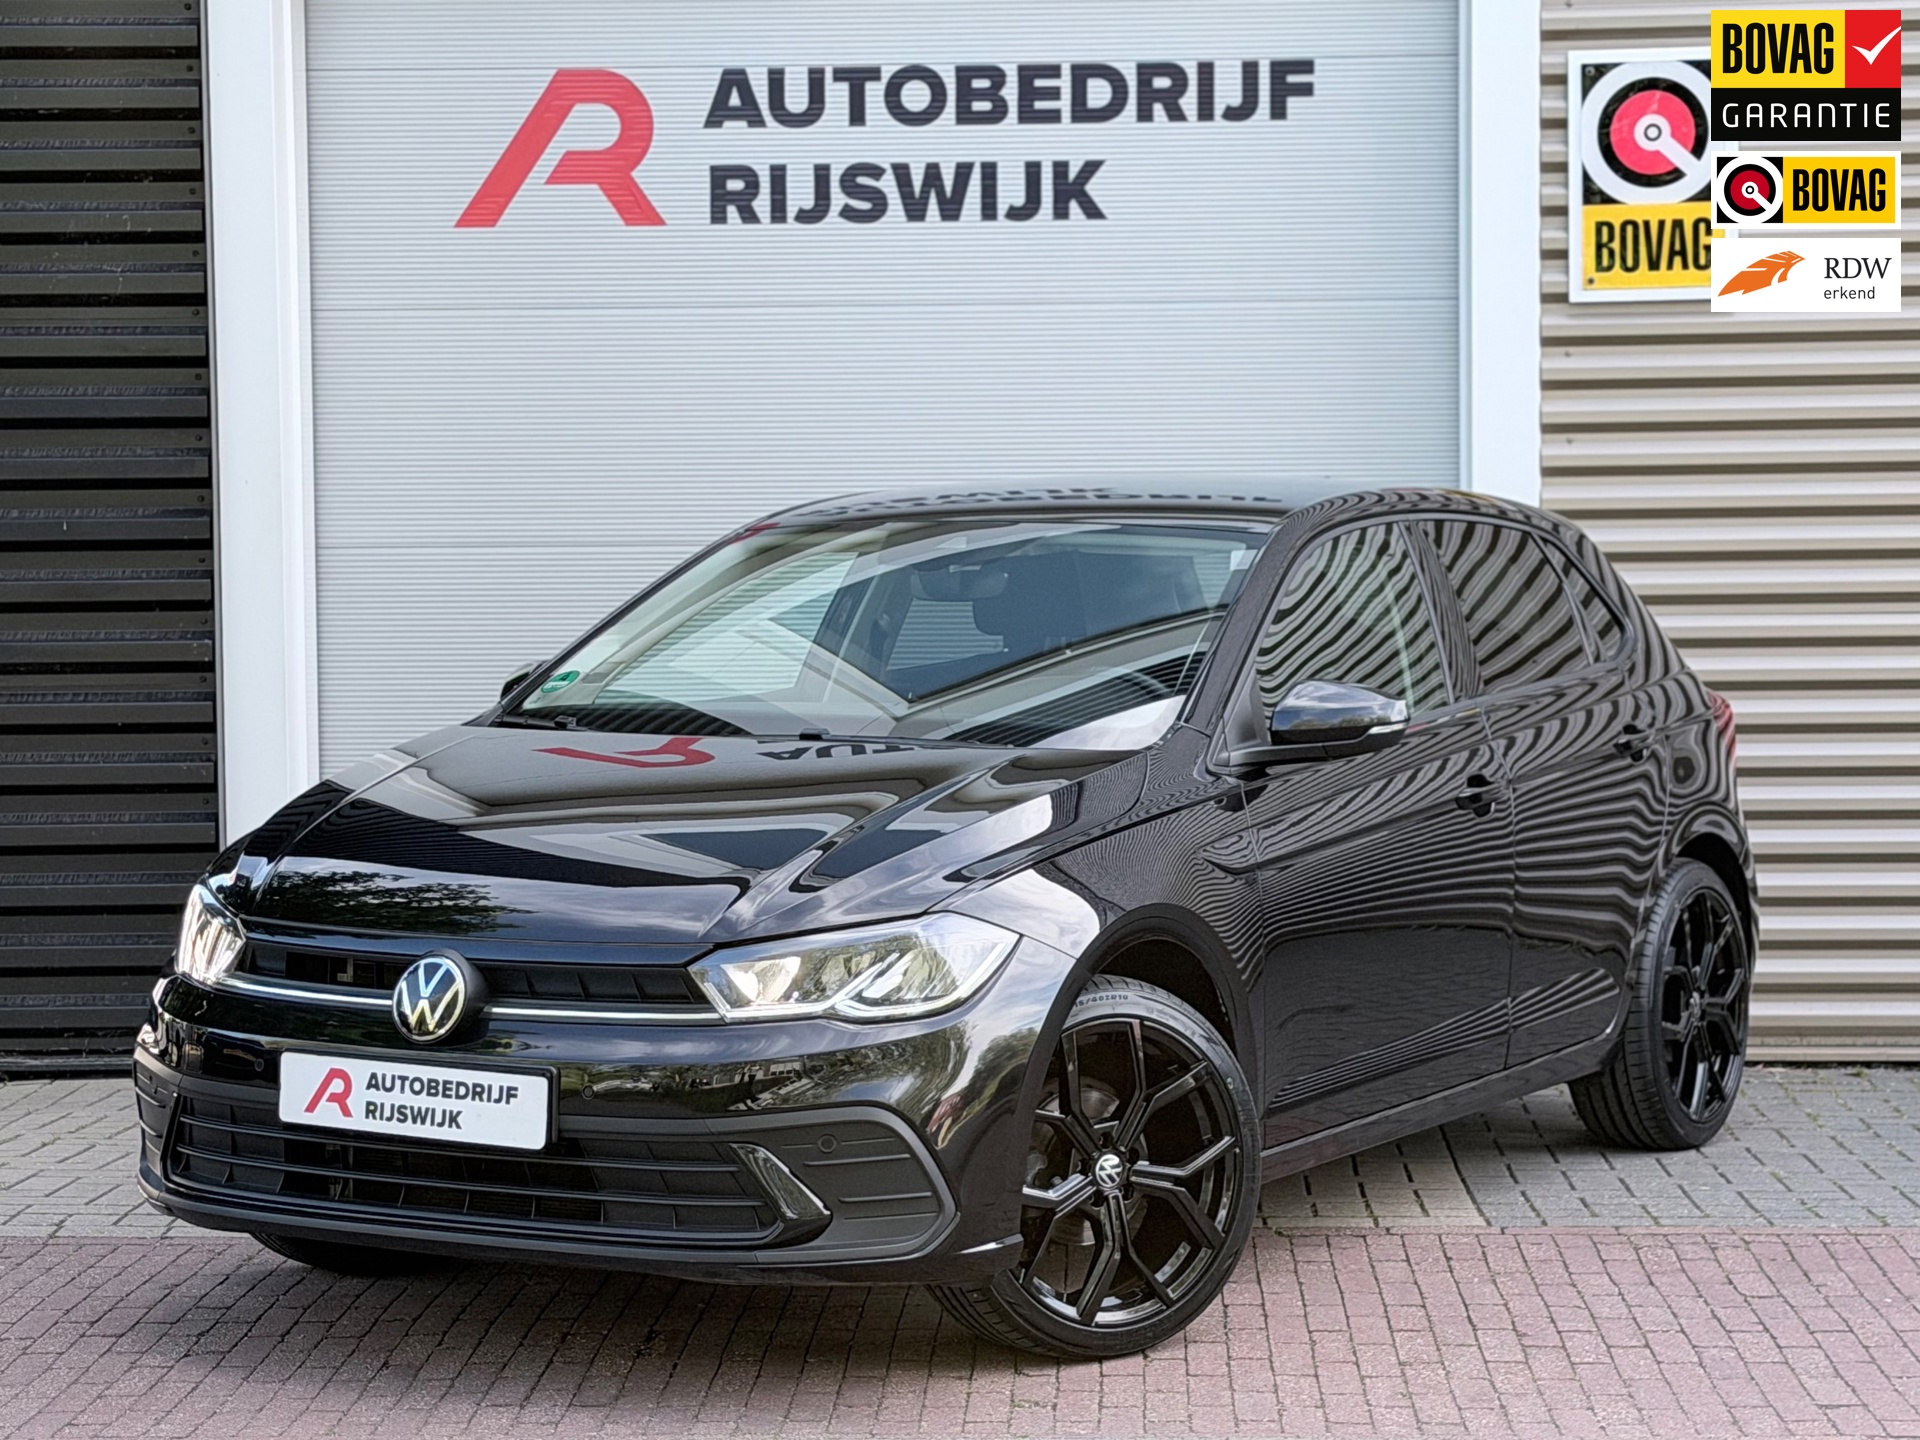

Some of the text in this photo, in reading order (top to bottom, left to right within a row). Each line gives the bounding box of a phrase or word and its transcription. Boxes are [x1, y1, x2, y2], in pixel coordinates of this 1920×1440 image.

[705, 59, 1315, 128] AUTOBEDRIJF
[710, 160, 1107, 225] RIJSWIJK
[365, 1072, 519, 1105] AUTOBEDRIJF
[364, 1101, 463, 1130] RIJSWIJK
